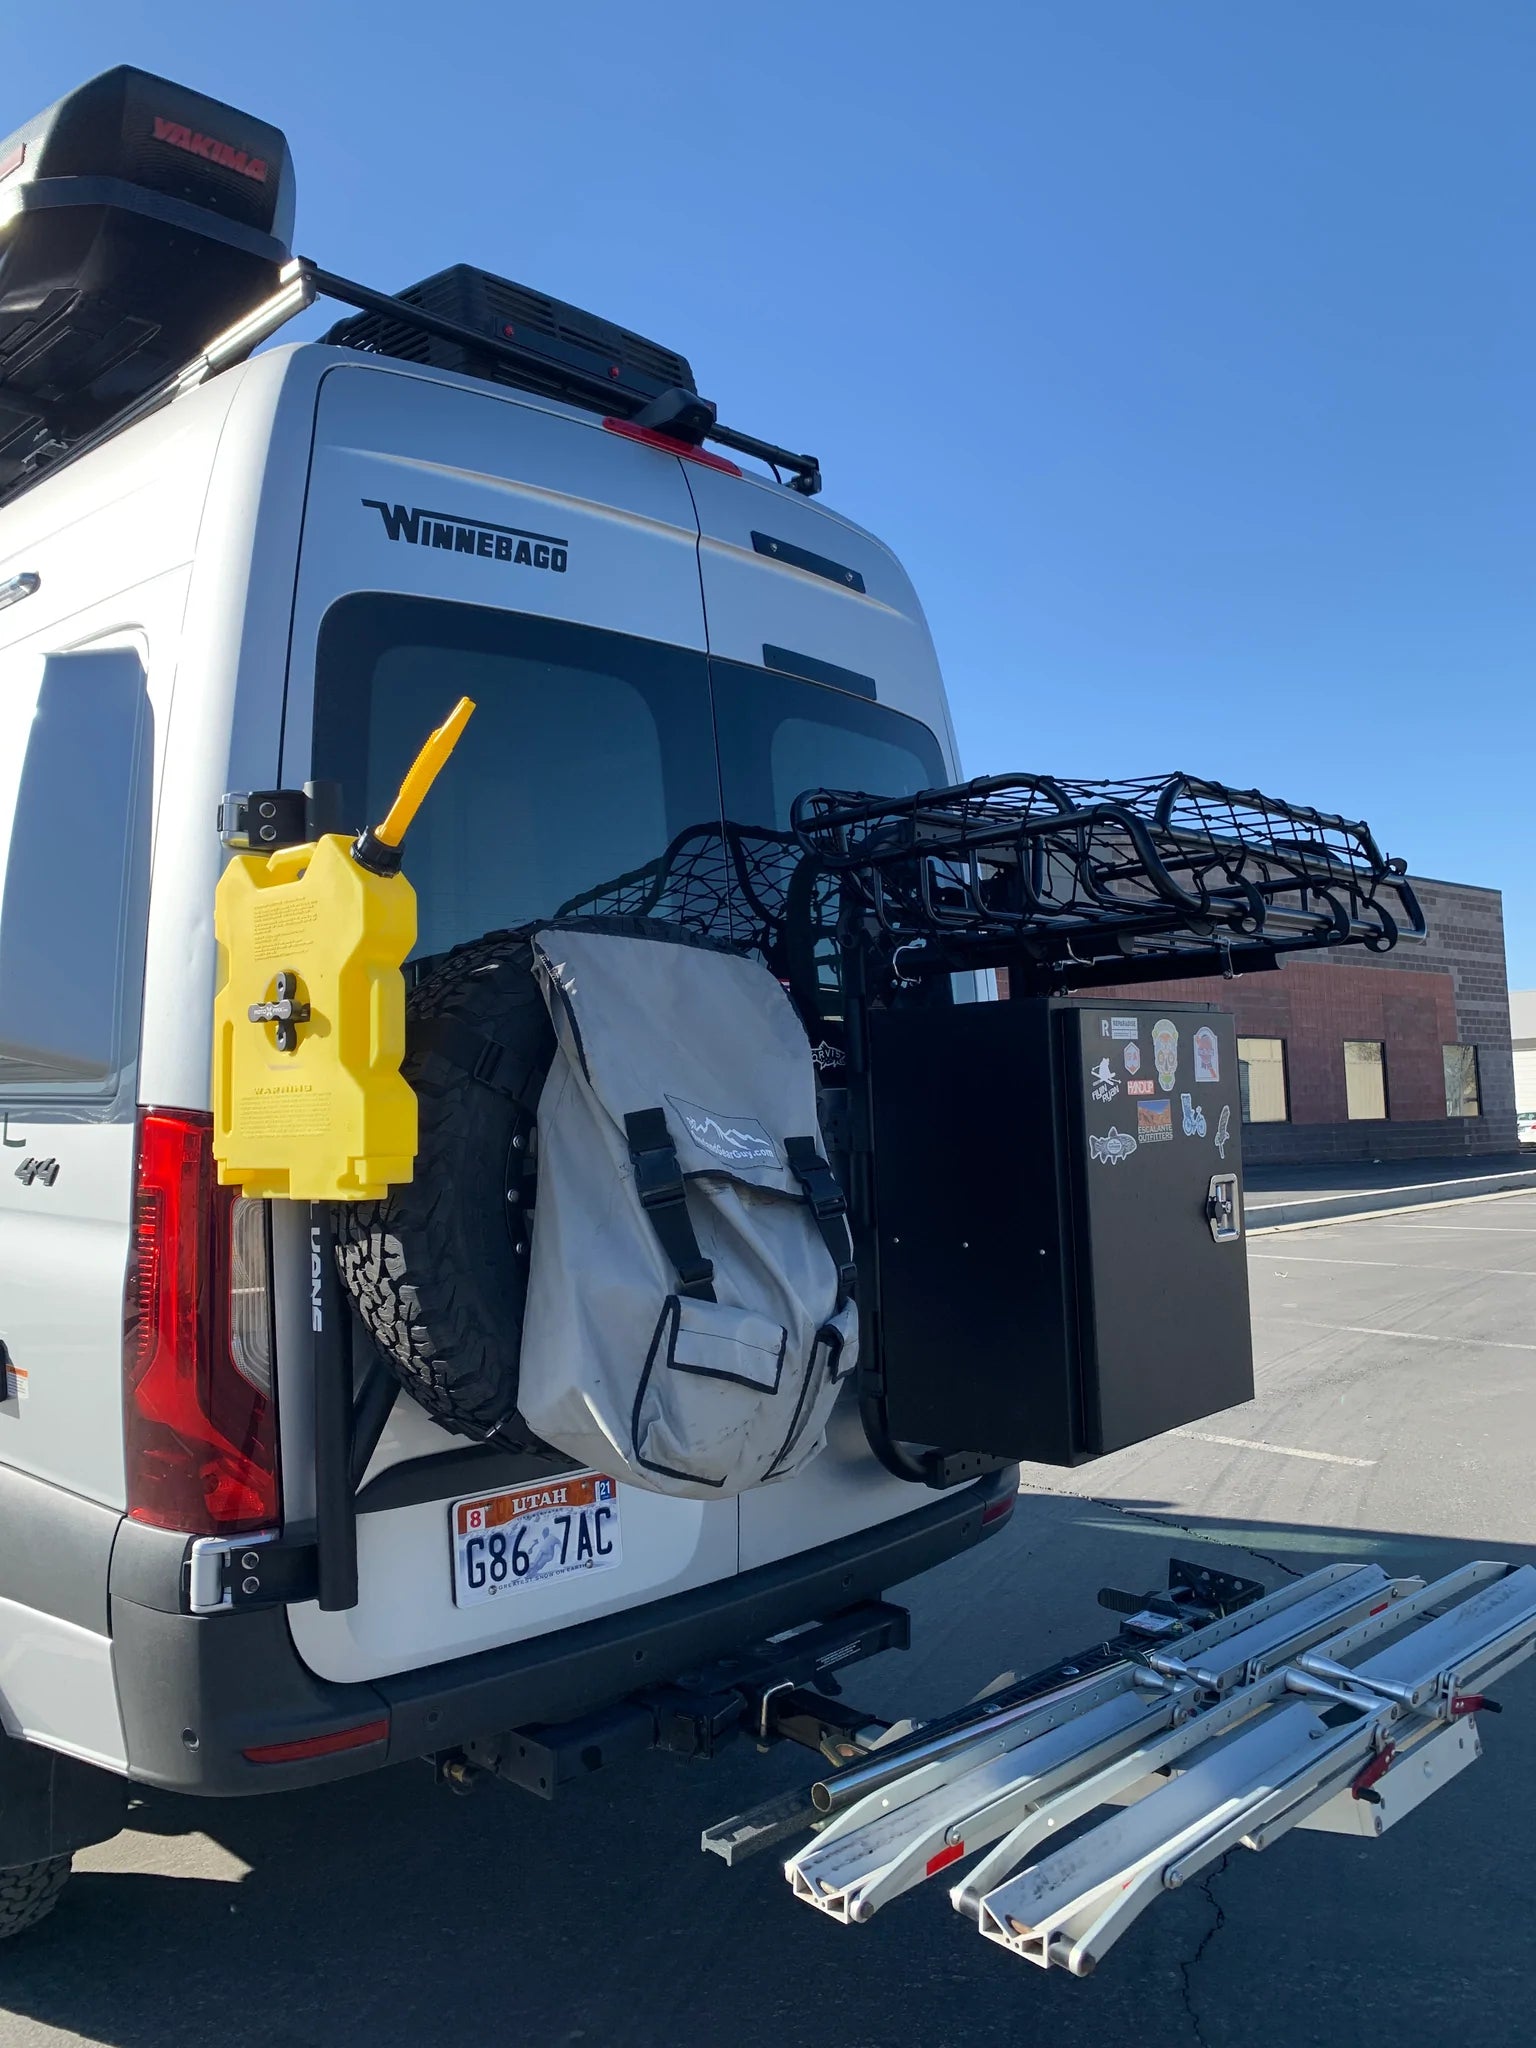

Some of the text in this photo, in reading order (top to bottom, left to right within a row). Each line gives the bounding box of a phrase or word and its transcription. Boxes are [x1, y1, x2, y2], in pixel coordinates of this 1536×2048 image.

[153, 116, 266, 182] YAKIMA
[361, 498, 568, 573] WINNEBAGO
[1138, 1124, 1173, 1133] ESCALANTE
[1138, 1131, 1174, 1142] OUTFITTERS
[600, 1480, 610, 1496] 21
[511, 1487, 568, 1515] UTAH
[470, 1510, 482, 1528] 8
[466, 1507, 613, 1589] G86 7AC
[535, 1571, 554, 1582] SNOW
[555, 1568, 566, 1576] ON
